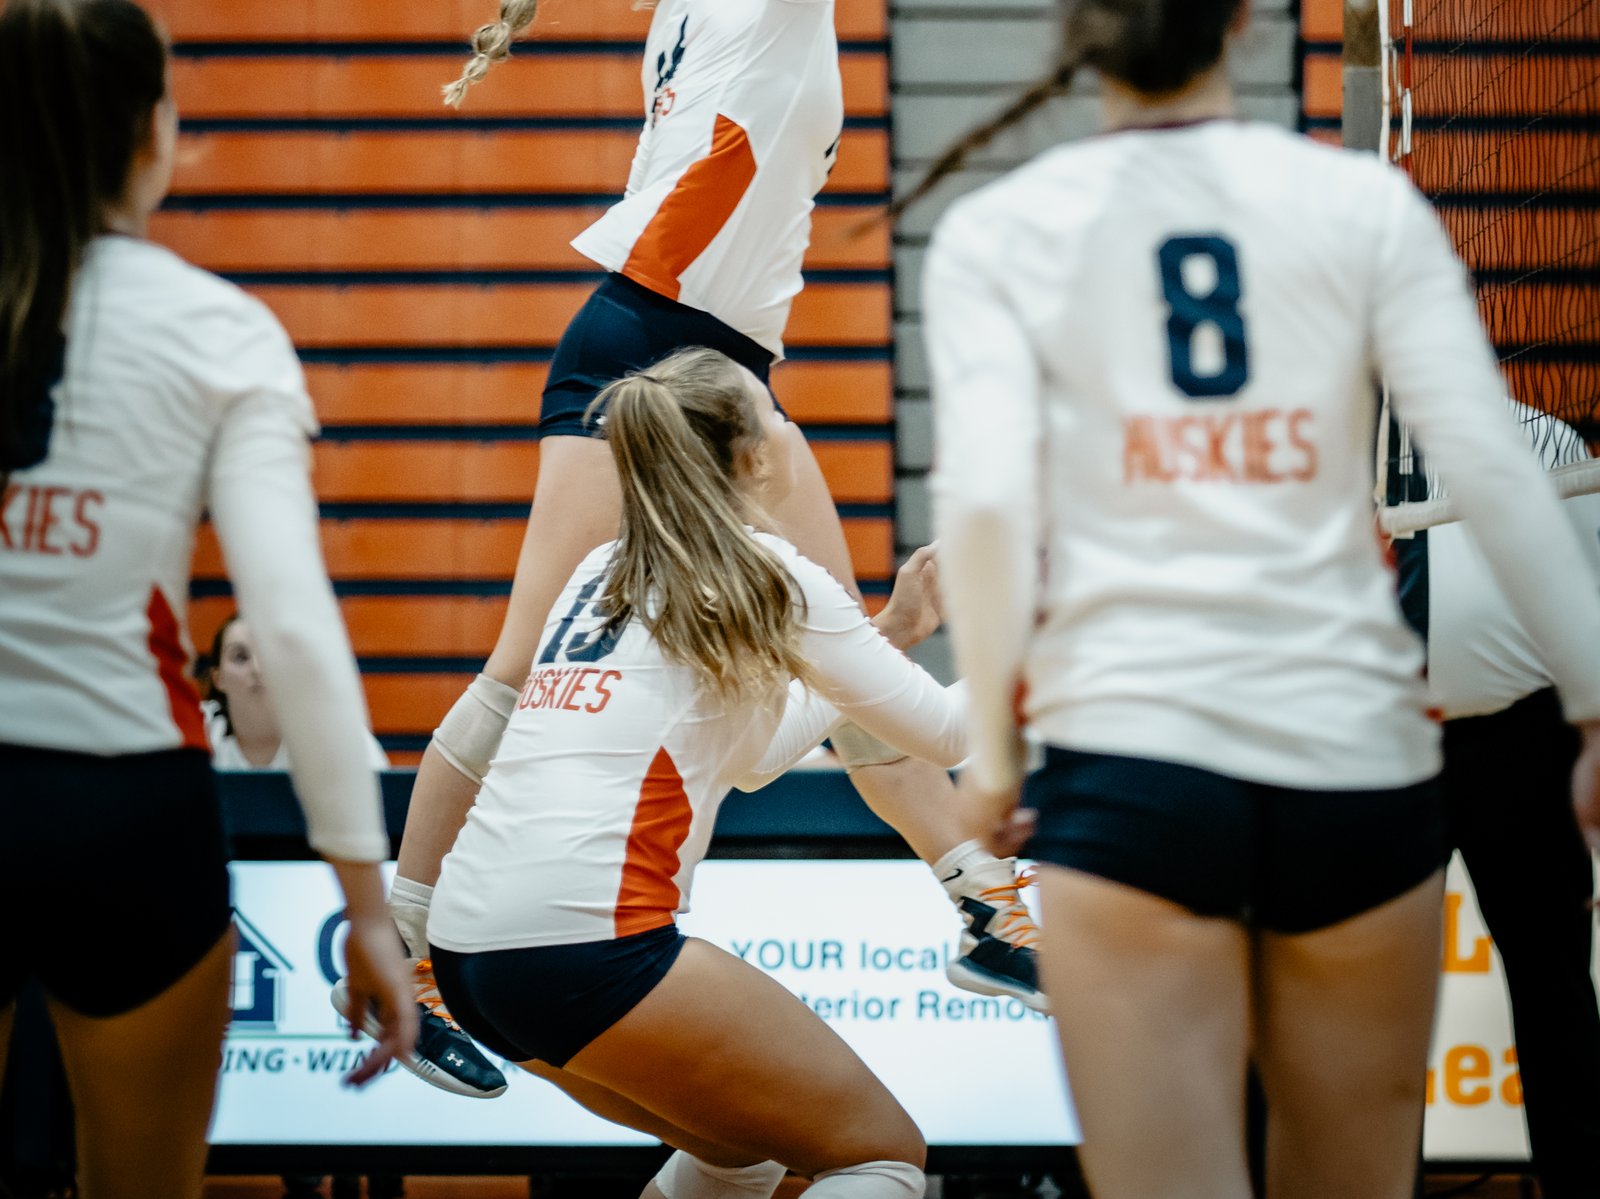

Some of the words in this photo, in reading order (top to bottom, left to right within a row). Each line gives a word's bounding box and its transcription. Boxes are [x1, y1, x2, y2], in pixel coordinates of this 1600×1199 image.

[1158, 236, 1248, 397] 8
[731, 940, 844, 971] YOUR
[860, 941, 949, 971] local
[802, 990, 901, 1021] erior
[917, 990, 1049, 1021] Remo
